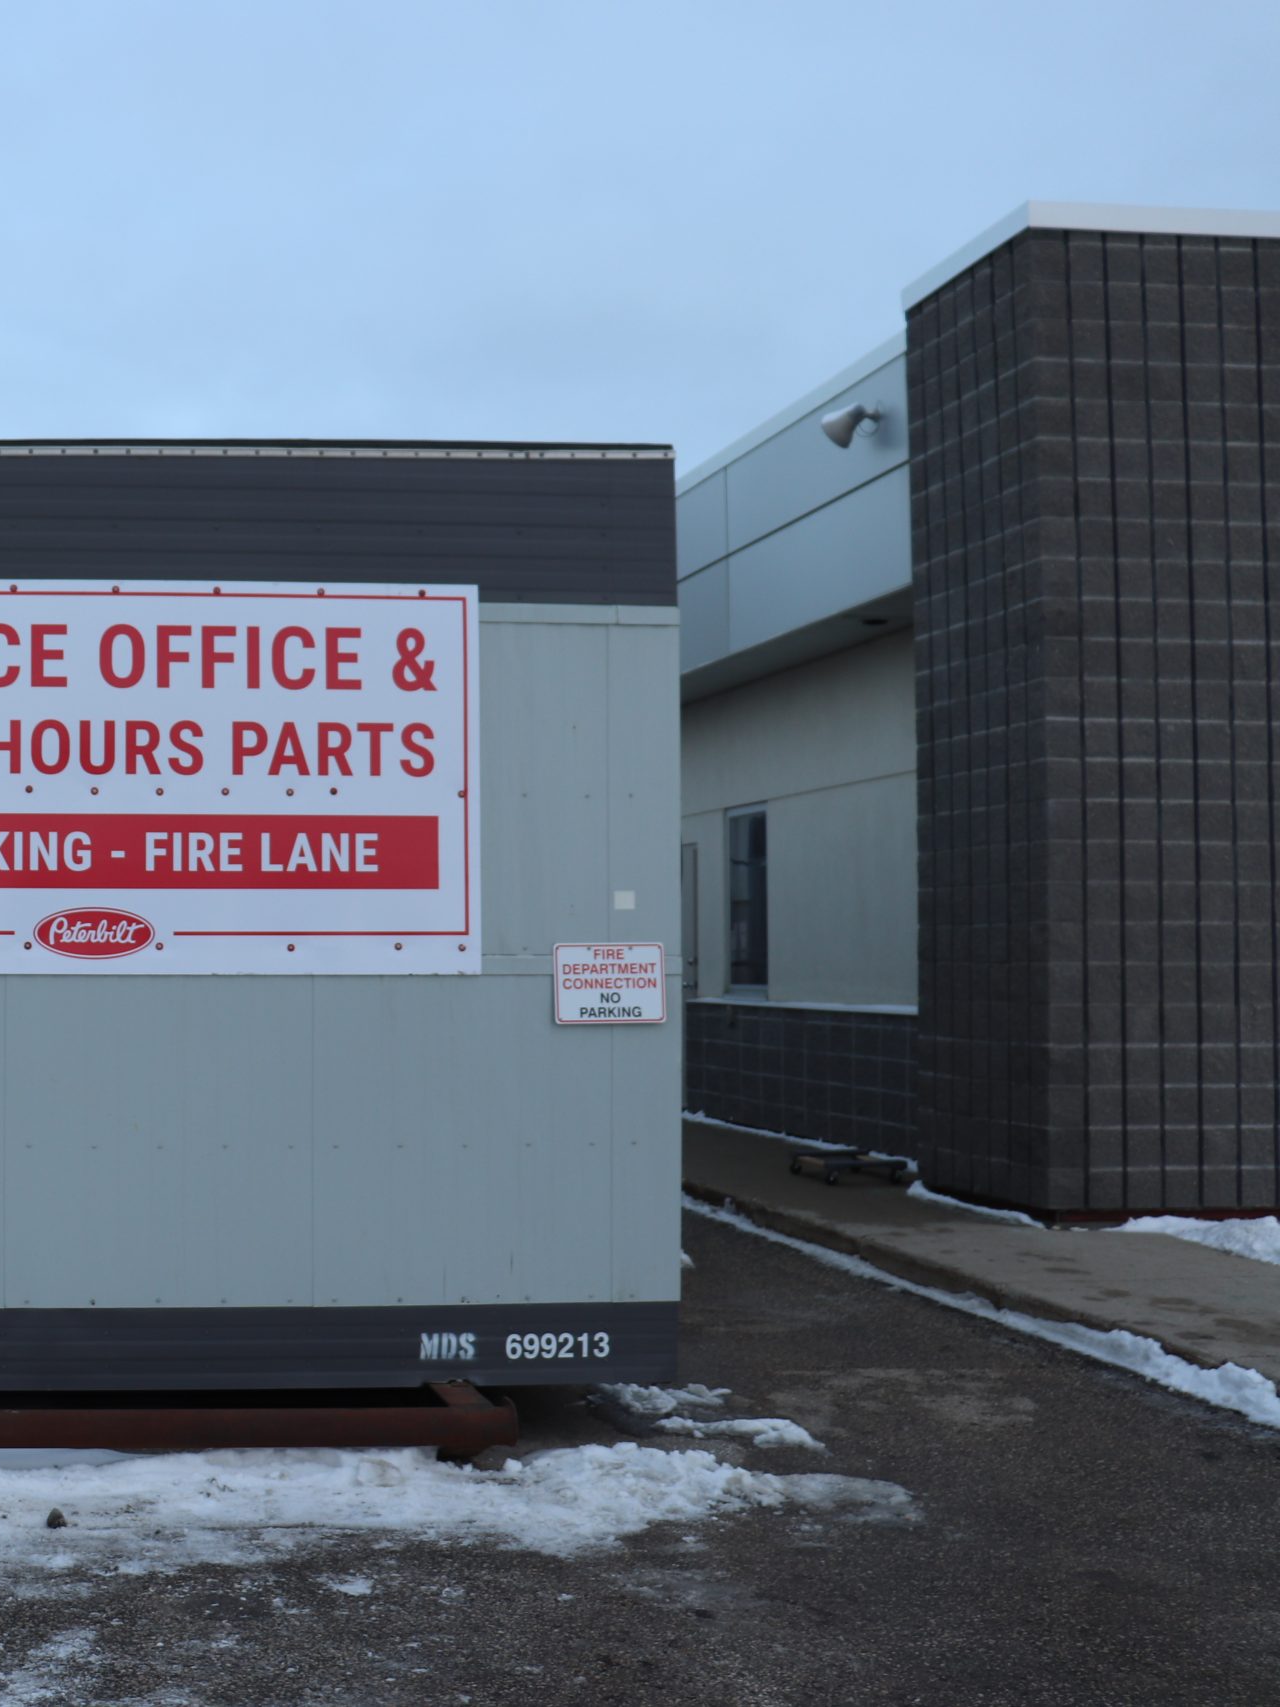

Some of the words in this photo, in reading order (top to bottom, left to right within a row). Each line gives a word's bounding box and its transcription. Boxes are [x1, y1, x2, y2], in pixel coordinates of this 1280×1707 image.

[99, 624, 363, 691] OFFICE
[392, 627, 437, 691] &
[231, 721, 435, 777] PARTS
[145, 832, 243, 872] FIRE
[261, 833, 378, 872] LANE
[47, 915, 144, 946] Peterbilt
[593, 948, 624, 959] FIRE
[562, 963, 656, 975] DEPARTMENT
[562, 978, 657, 989] CONNECTION
[600, 992, 620, 1003] NO
[580, 1007, 642, 1018] PARKING
[419, 1332, 476, 1361] MDS
[505, 1332, 610, 1361] 699213
